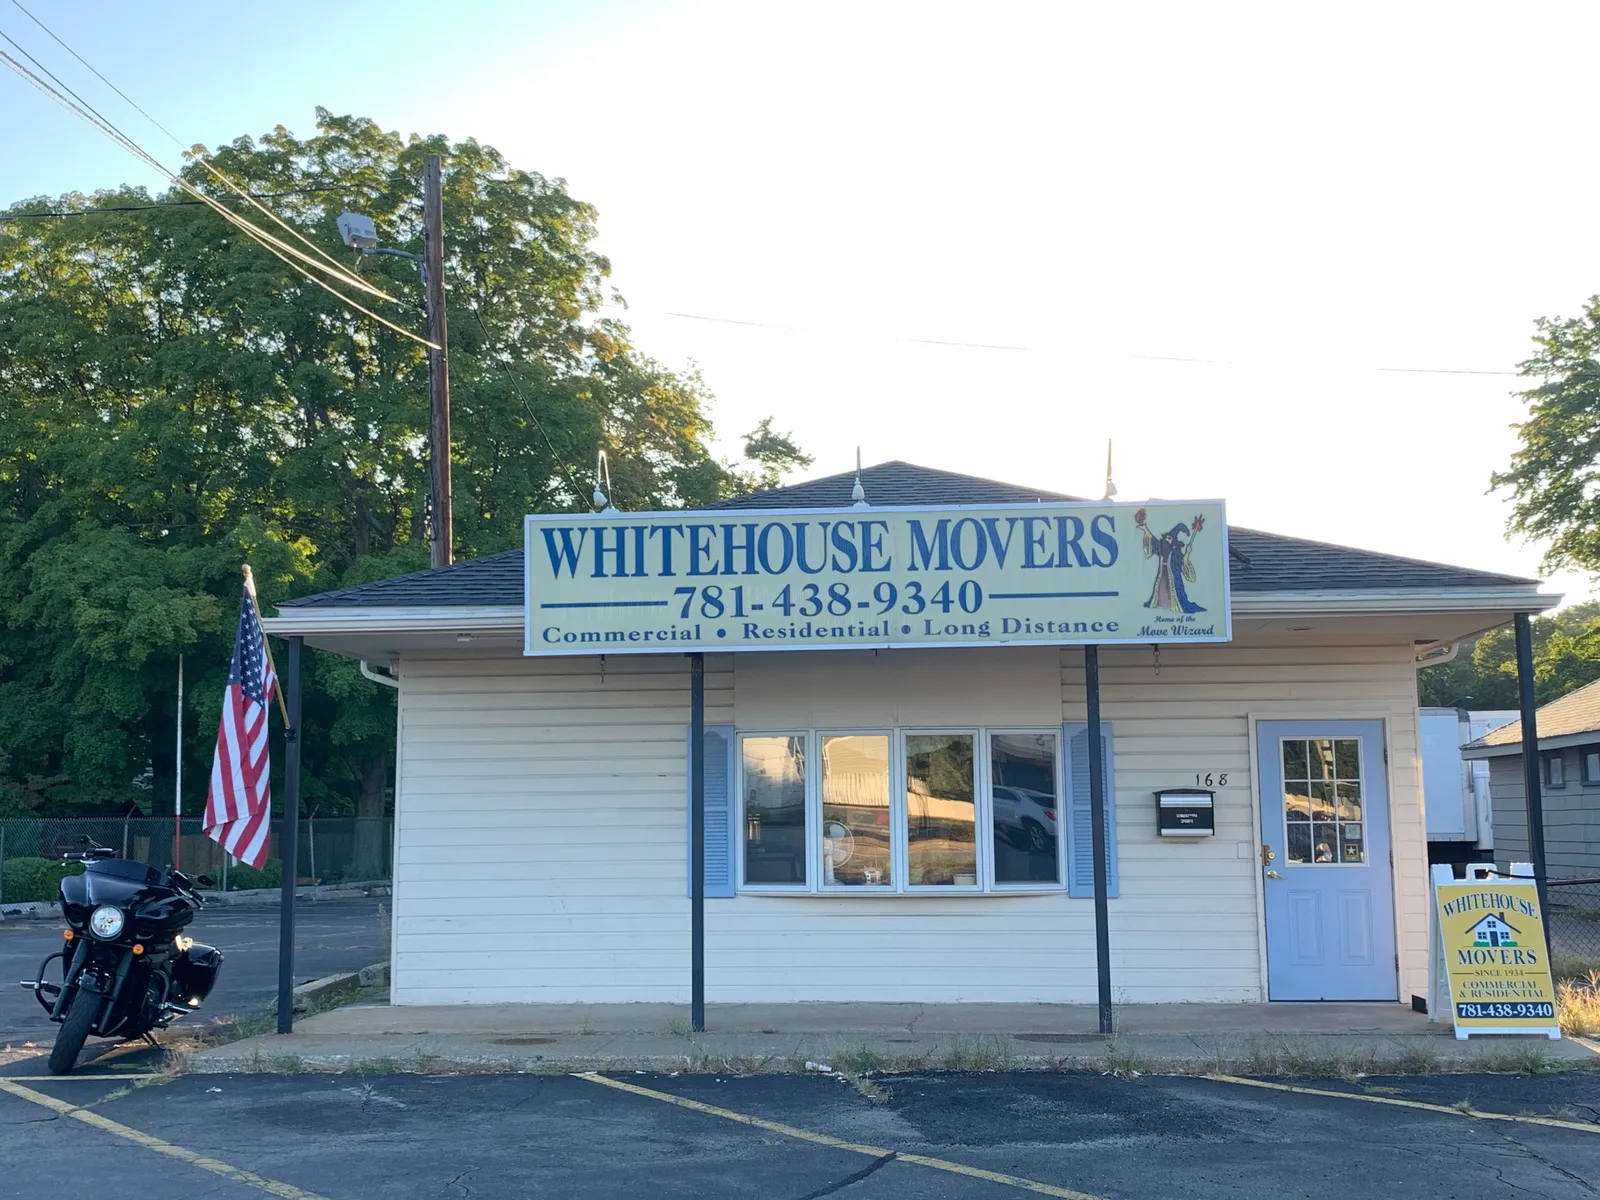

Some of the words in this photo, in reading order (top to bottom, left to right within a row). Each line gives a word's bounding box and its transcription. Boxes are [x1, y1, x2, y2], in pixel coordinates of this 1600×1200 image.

[540, 520, 892, 579] WHITEHOUSE
[907, 514, 1119, 572] MOVERS
[673, 579, 983, 619] 781-438-9340
[1154, 615, 1174, 623] Home
[1176, 615, 1184, 624] of
[542, 624, 701, 643] Commercial
[743, 620, 889, 639] Residential
[923, 618, 991, 638] Long
[1001, 617, 1120, 634] Distance
[1137, 626, 1168, 636] Move
[1170, 625, 1214, 636] Wizard
[1196, 773, 1228, 787] 168
[1443, 893, 1538, 920] WHITEHOUSE
[1458, 949, 1537, 965] MOVERS
[1475, 969, 1502, 977] SINCE
[1462, 981, 1540, 989] COMMERCIAL
[1459, 990, 1466, 998] &
[1471, 989, 1546, 998] RESIDENTIAL
[1459, 1004, 1552, 1017] 781-438-9340
